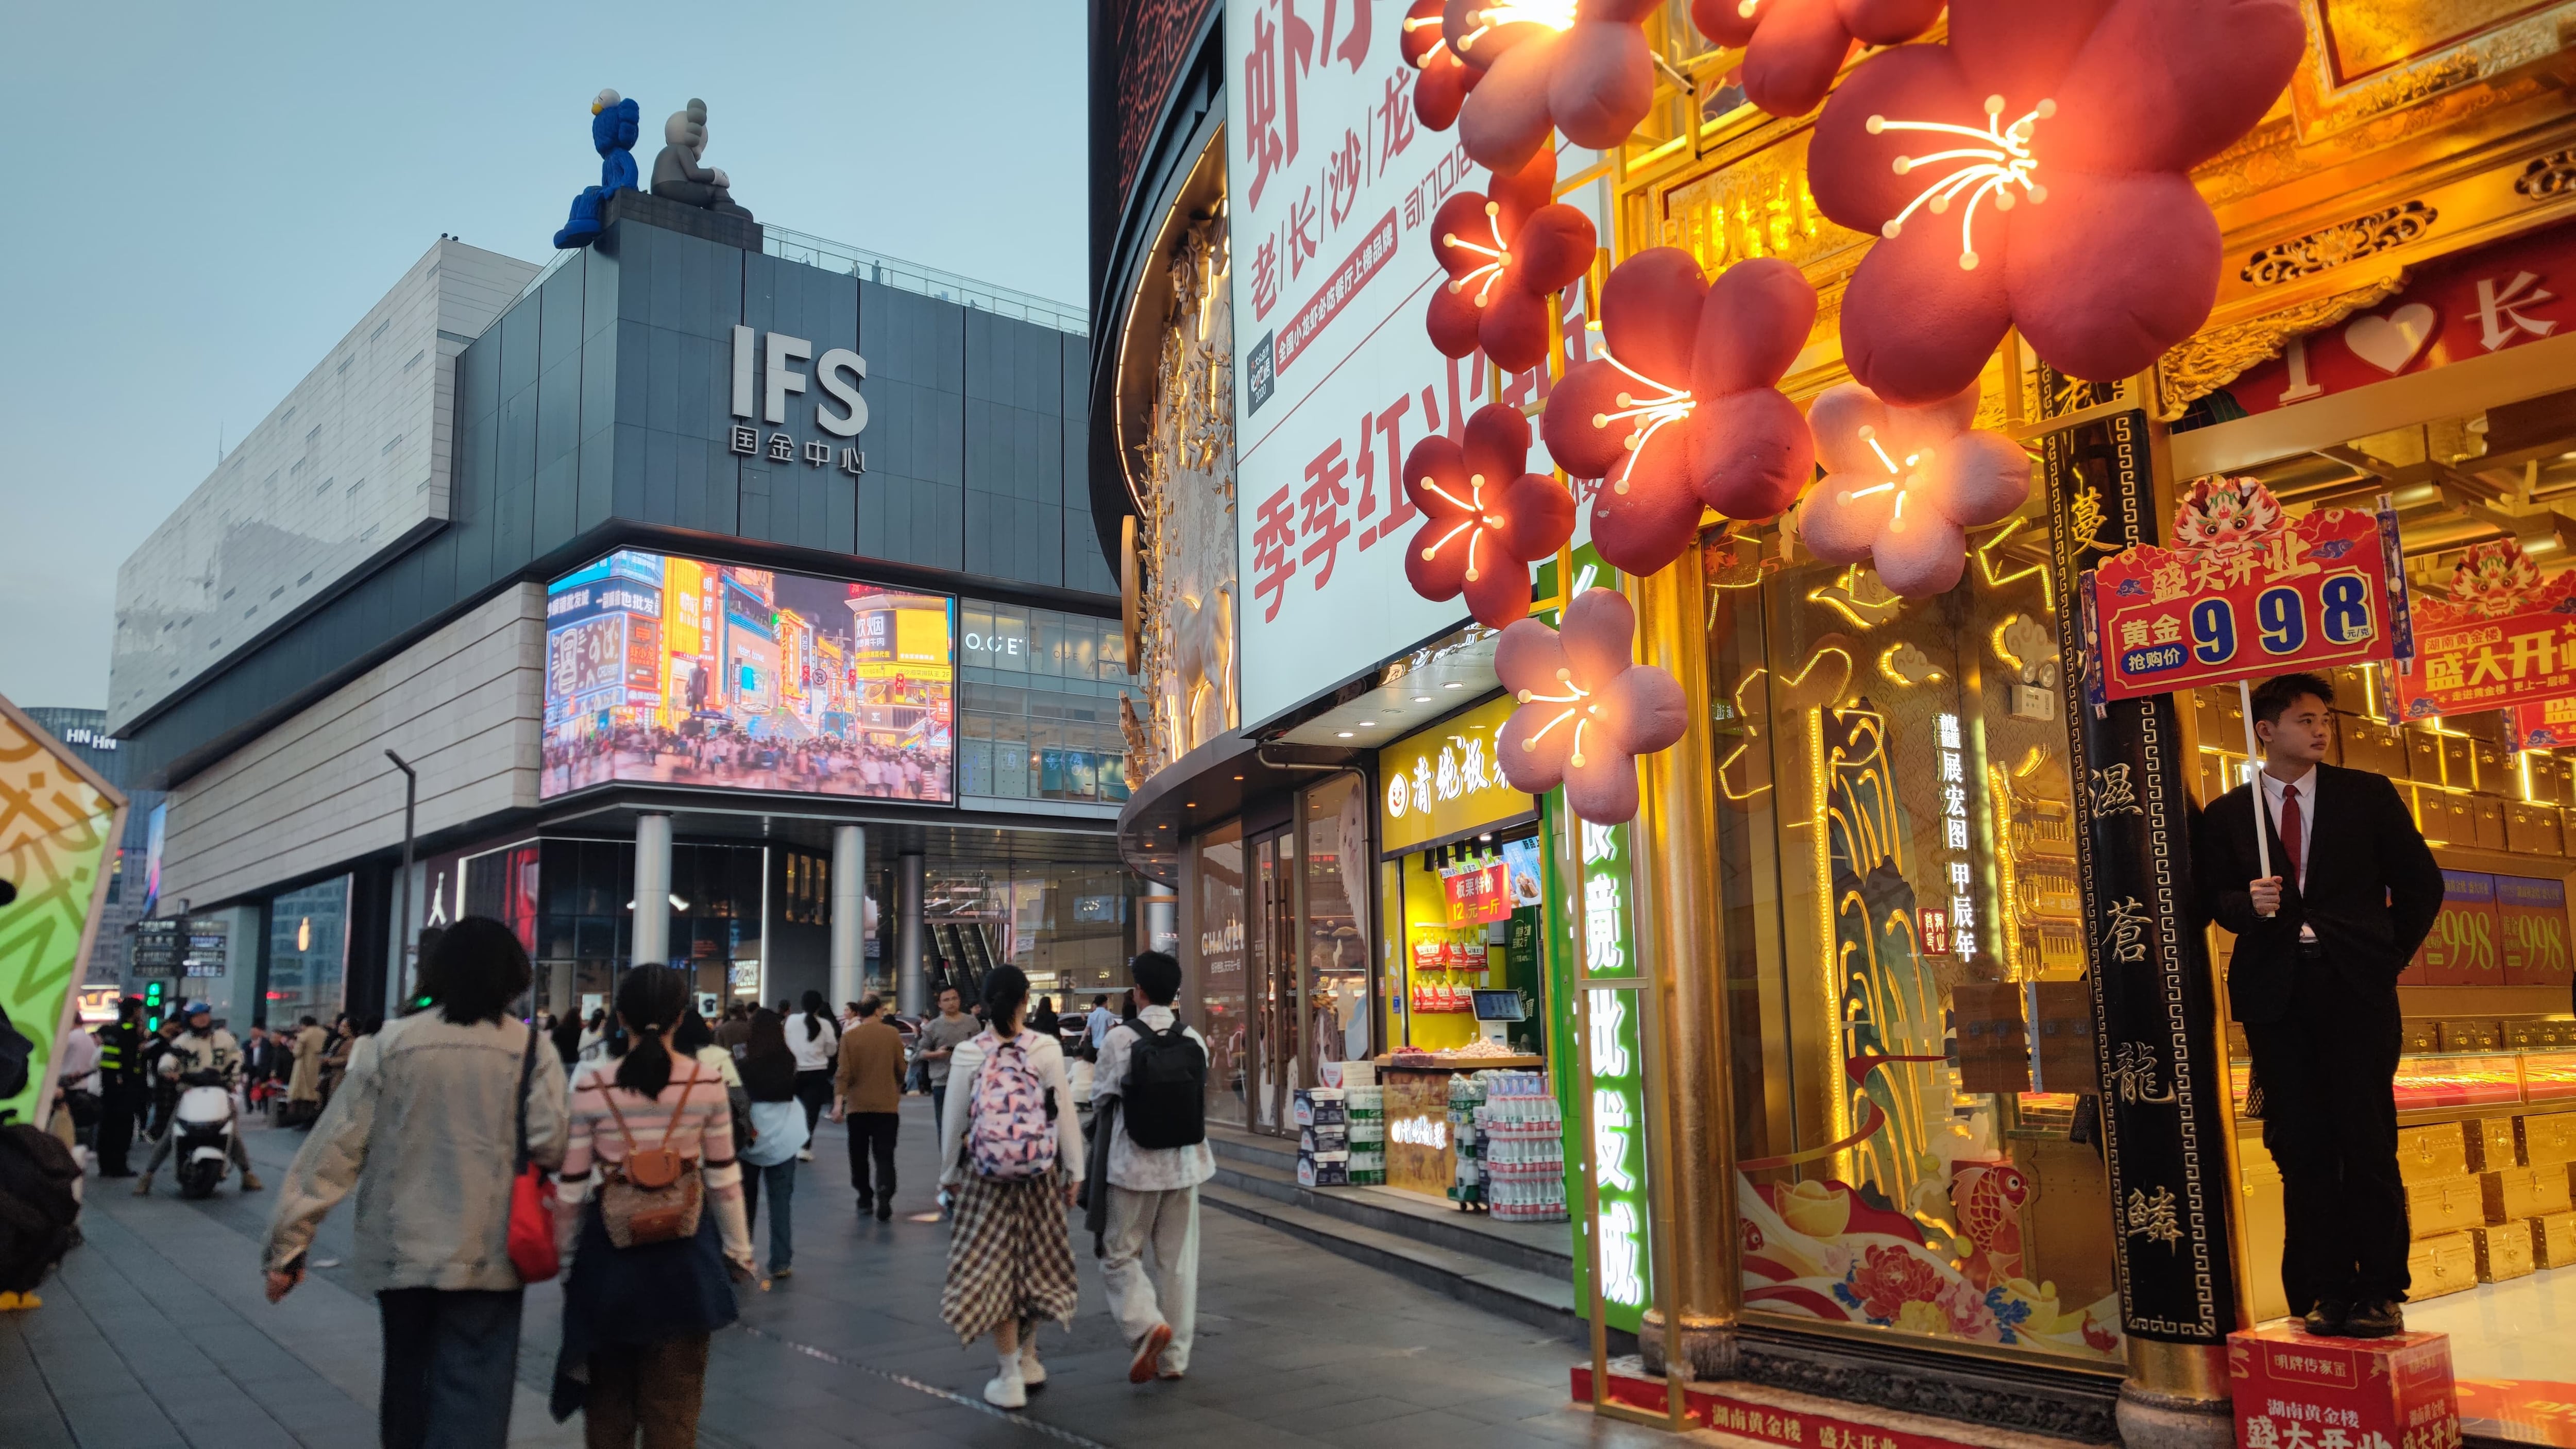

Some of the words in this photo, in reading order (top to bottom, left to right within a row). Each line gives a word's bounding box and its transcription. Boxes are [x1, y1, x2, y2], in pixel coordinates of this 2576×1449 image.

[2279, 335, 2324, 406] I
[2464, 270, 2560, 352] 长
[732, 325, 869, 436] IFS
[1256, 383, 1266, 403] 2020
[731, 424, 866, 475] 国金中心
[2149, 532, 2320, 606] 盛大开业
[2121, 613, 2182, 652] 黄金
[2189, 573, 2370, 667] 998
[2426, 627, 2500, 651] 湖南黄金楼
[2127, 647, 2181, 672] 抢购价
[2513, 674, 2570, 693] 更上一层楼
[1456, 873, 1494, 899] 板栗特价
[1951, 861, 1977, 963] 甲辰年
[2441, 909, 2494, 970] 998
[2518, 915, 2565, 971] 998
[2274, 1354, 2347, 1378] 明牌传家金
[1712, 1404, 1802, 1443] 湖南黄金楼
[2267, 1399, 2360, 1429] 湖南黄金楼
